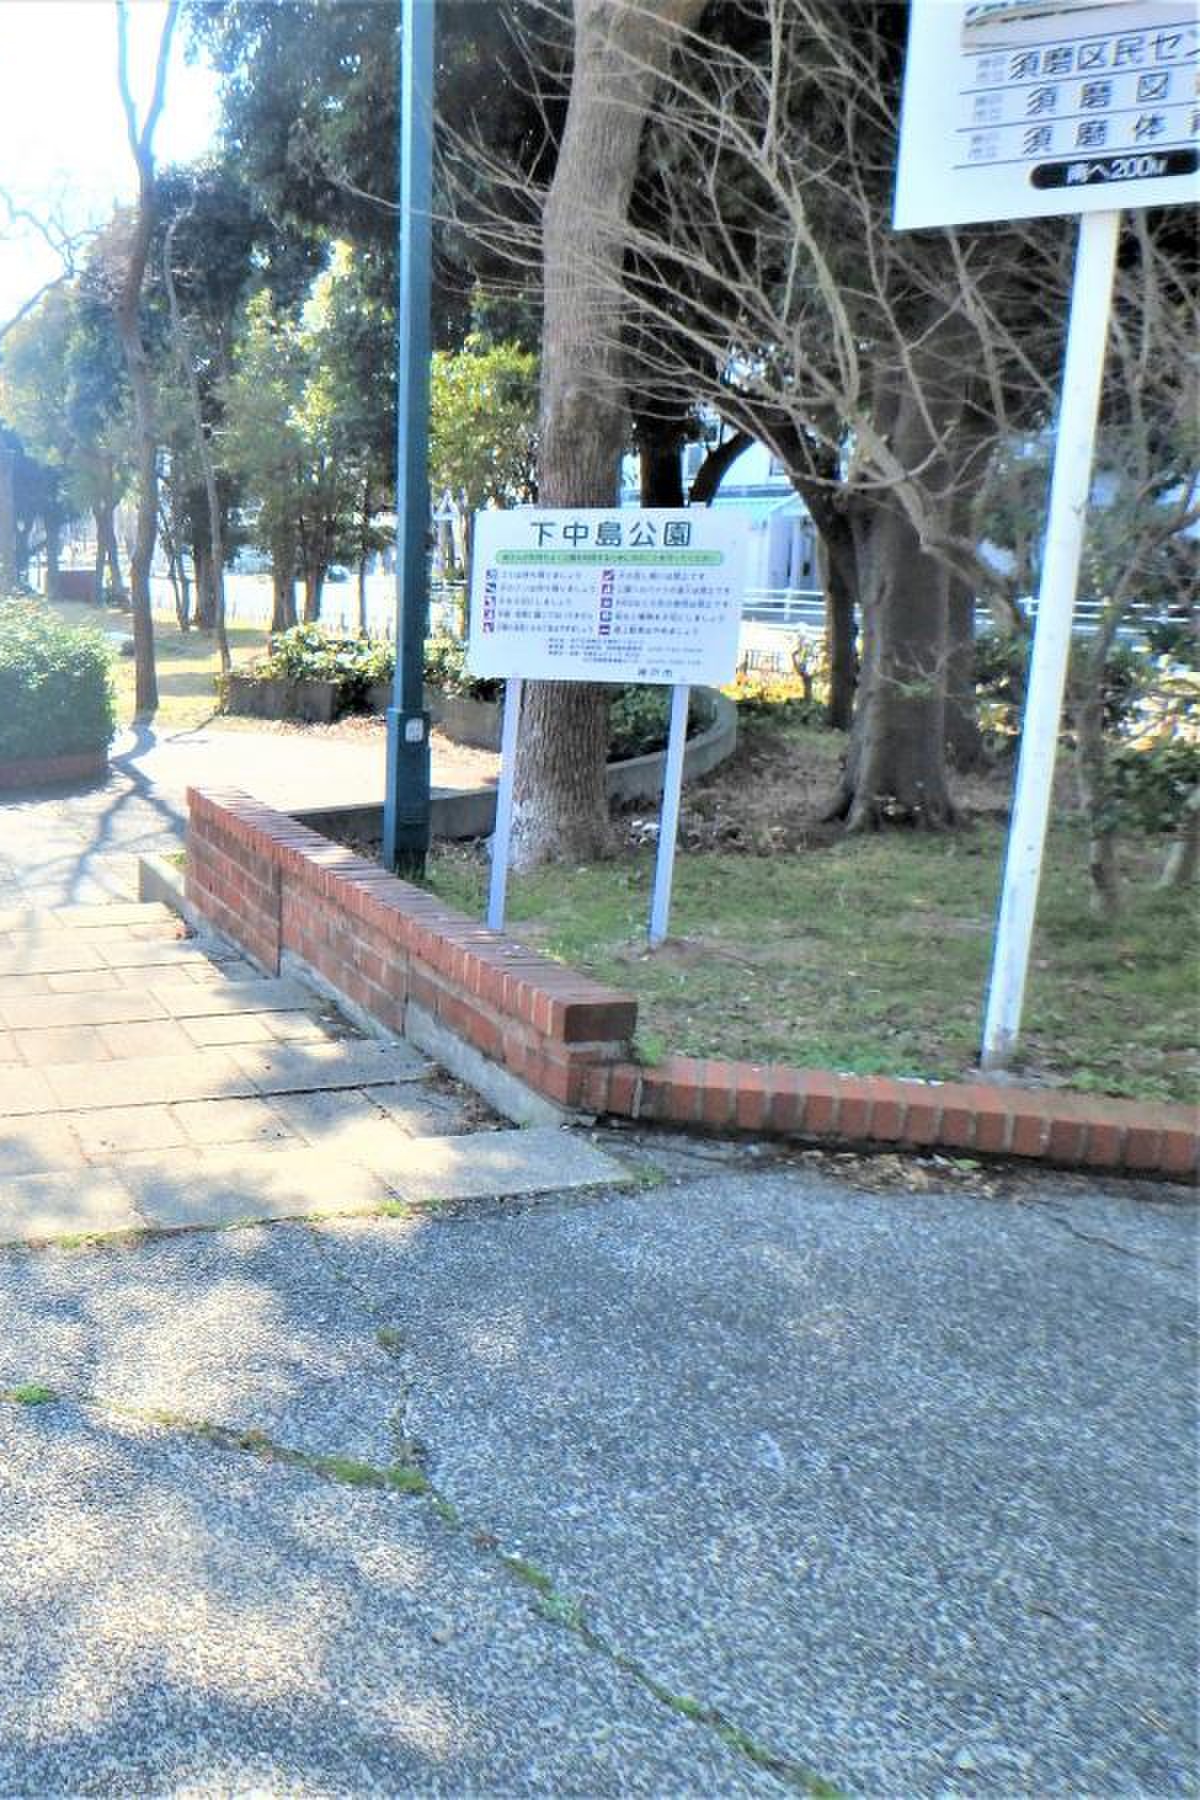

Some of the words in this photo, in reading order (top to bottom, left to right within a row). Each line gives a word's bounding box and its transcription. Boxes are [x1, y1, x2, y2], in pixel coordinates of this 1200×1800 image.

[1026, 70, 1200, 116] 須磨図
[530, 521, 692, 547] 下中島公園
